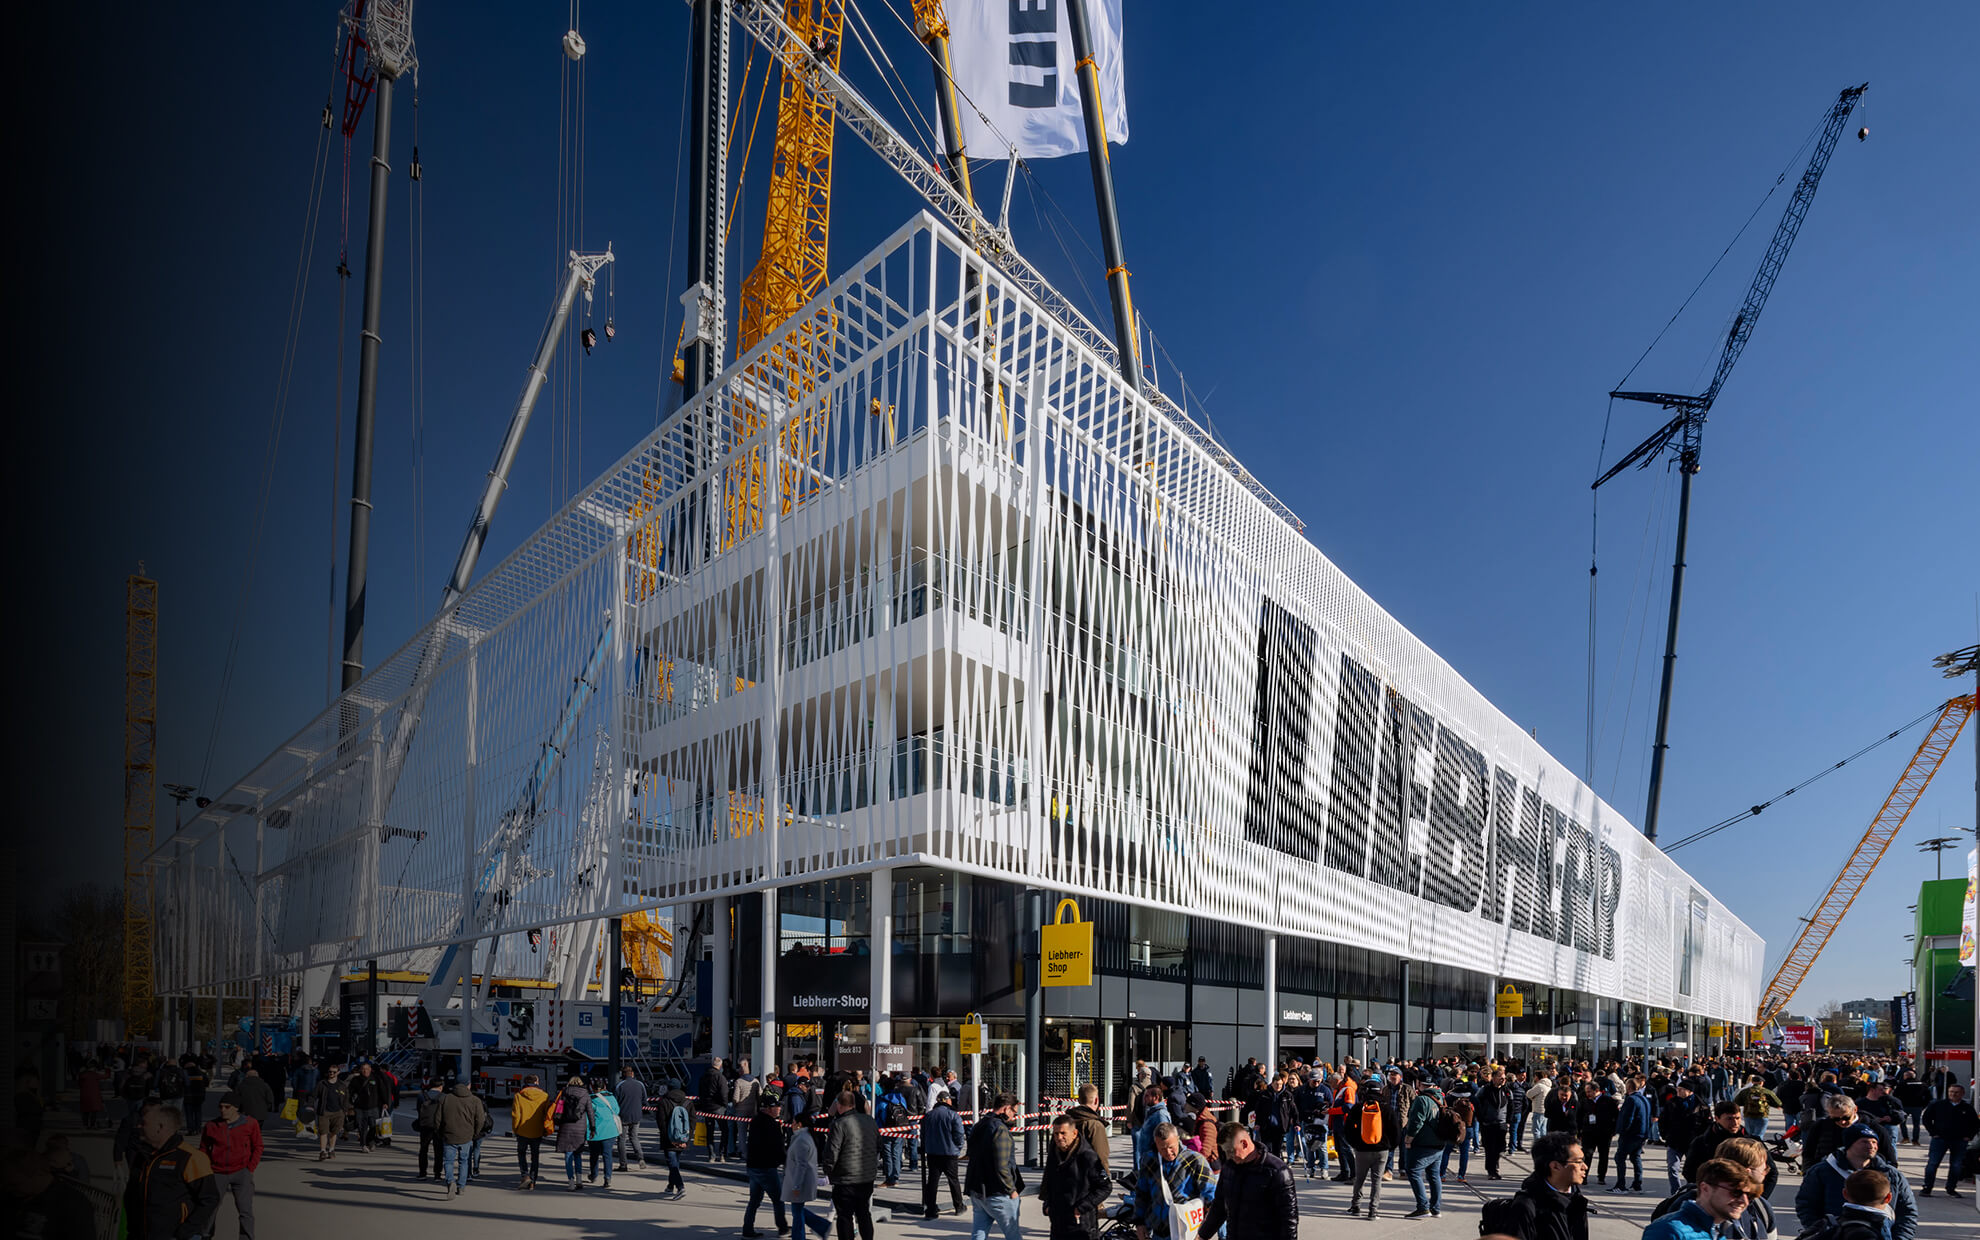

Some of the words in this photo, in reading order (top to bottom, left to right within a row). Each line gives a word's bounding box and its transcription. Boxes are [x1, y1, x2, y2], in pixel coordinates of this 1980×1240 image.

[1244, 595, 1622, 961] LIEBHERR
[1048, 950, 1084, 961] Liebherr-
[1048, 962, 1068, 974] Shop
[793, 994, 869, 1009] Liebherr-Shop
[839, 1046, 852, 1054] Block
[852, 1046, 862, 1054] 813
[878, 1046, 893, 1054] Block
[893, 1046, 904, 1055] 813
